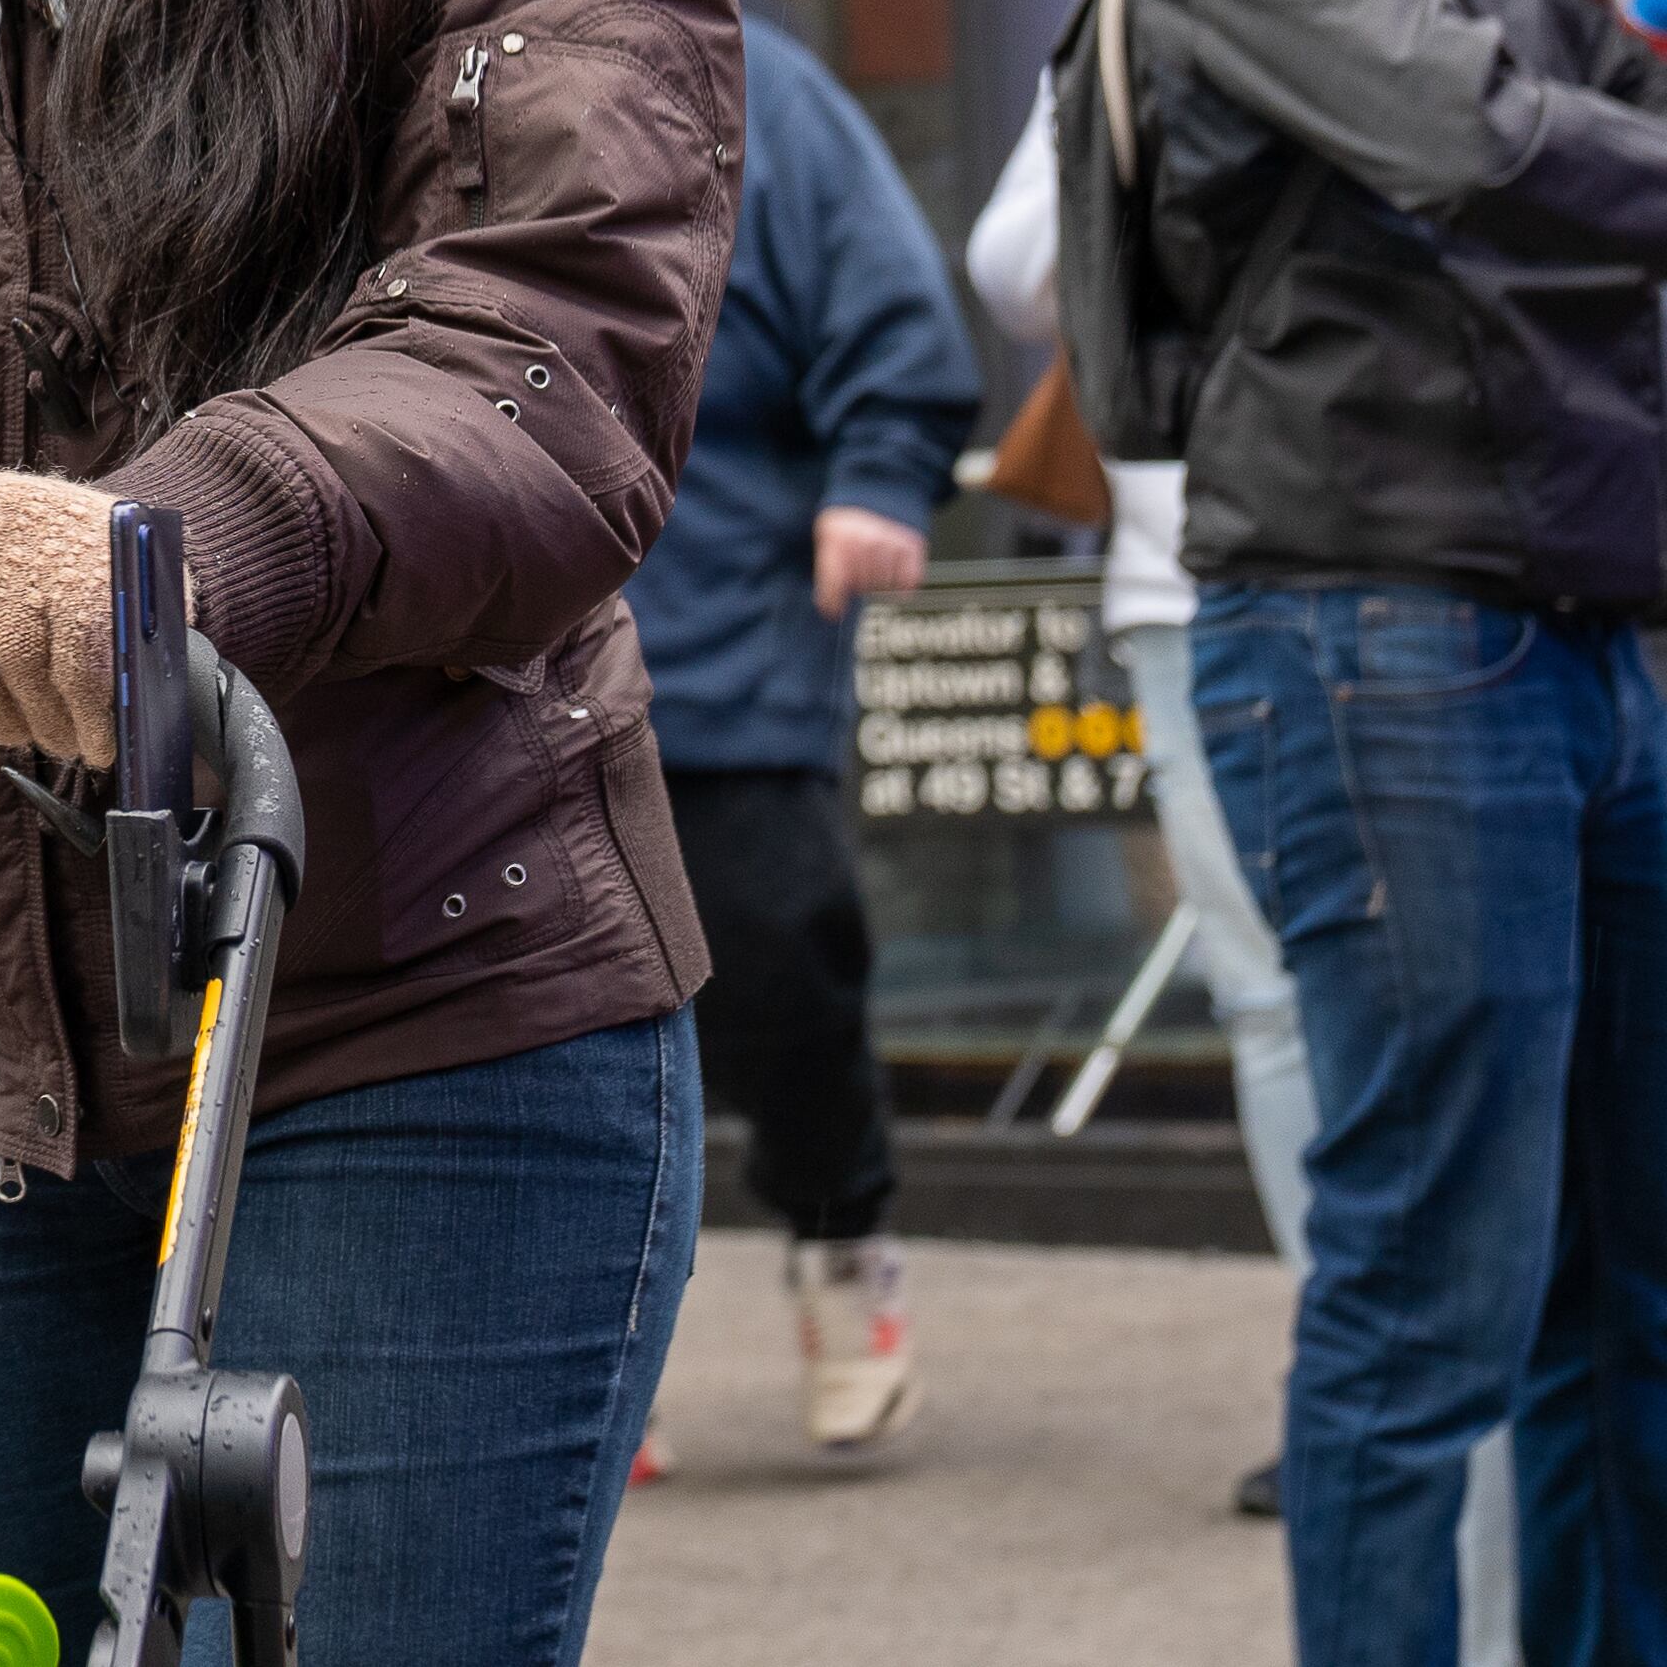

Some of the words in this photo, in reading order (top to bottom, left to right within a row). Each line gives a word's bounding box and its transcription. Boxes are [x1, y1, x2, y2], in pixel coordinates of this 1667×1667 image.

[855, 604, 1026, 660] Elevator
[1035, 600, 1092, 654] to
[854, 657, 1025, 710] Uptown
[1027, 651, 1071, 706] &
[857, 710, 1026, 765] Queens
[861, 765, 915, 816] at
[917, 757, 990, 815] 49
[991, 757, 1052, 814] St
[1058, 753, 1104, 814] &
